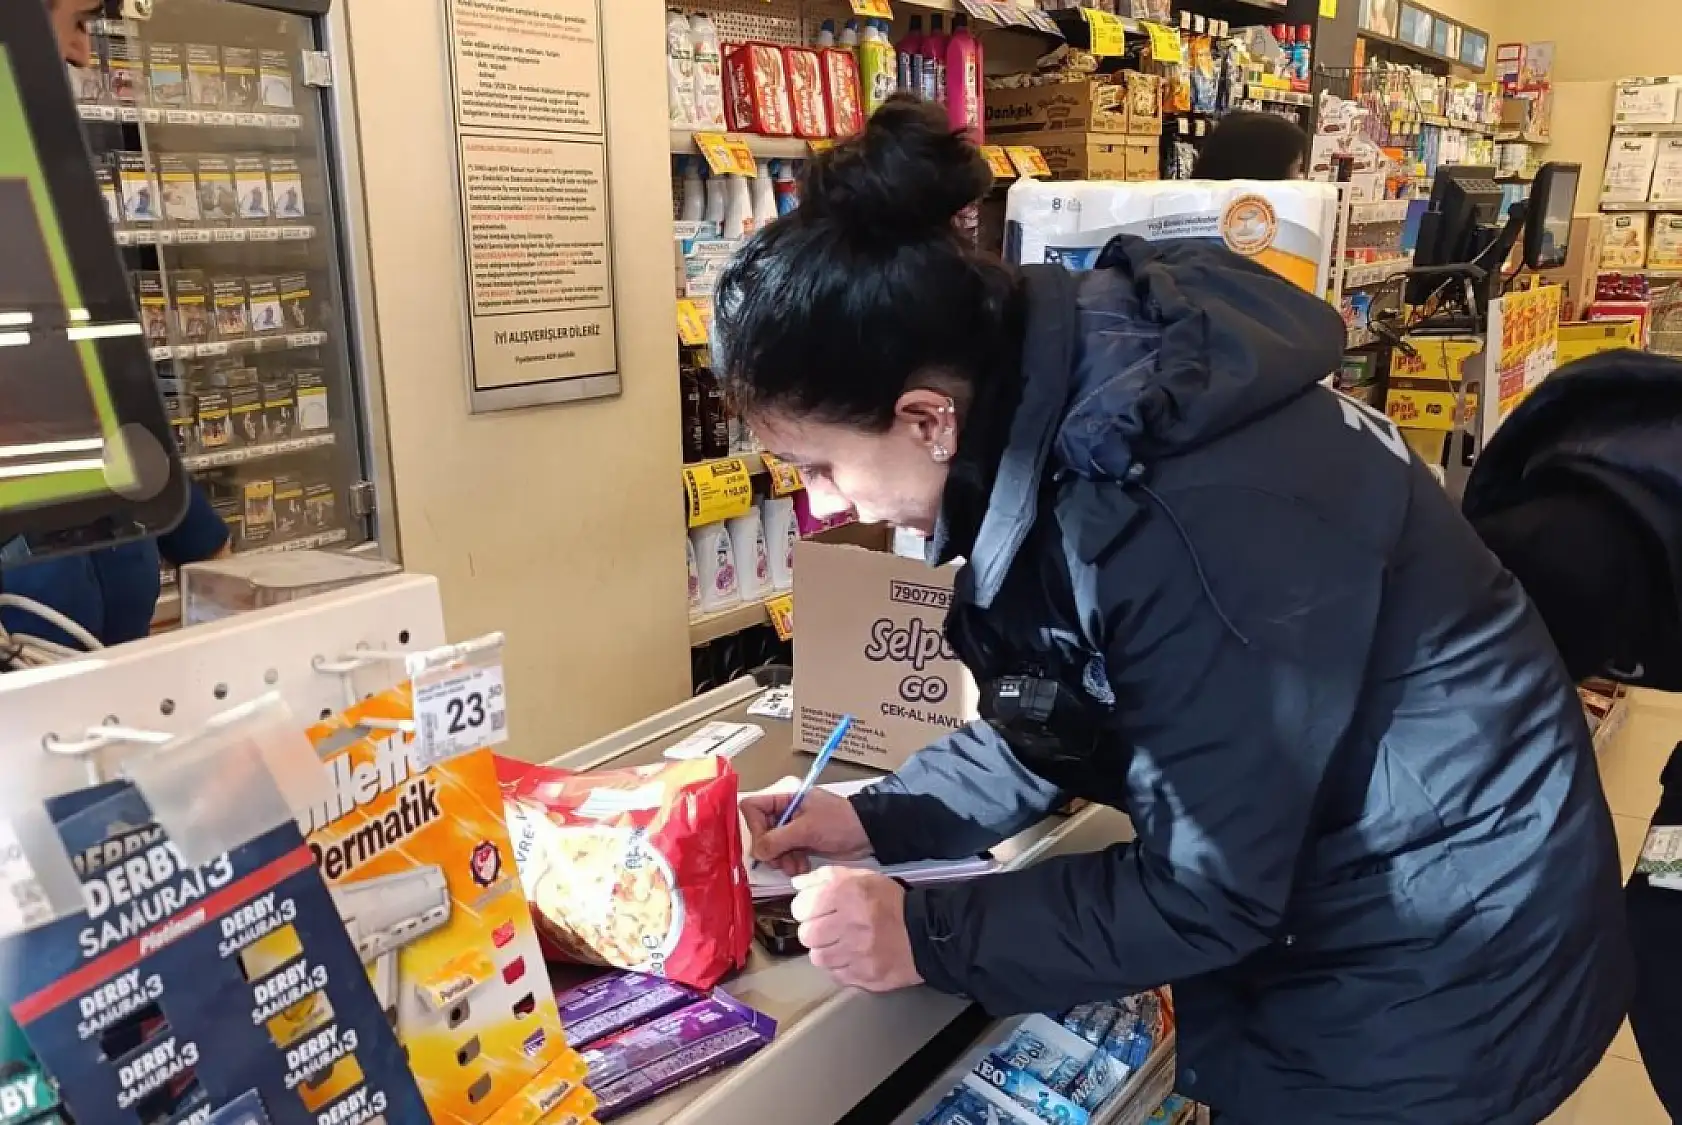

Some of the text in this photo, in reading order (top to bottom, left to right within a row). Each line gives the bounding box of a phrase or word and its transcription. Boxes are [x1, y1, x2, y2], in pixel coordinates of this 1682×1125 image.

[1052, 197, 1061, 210] 8
[508, 325, 569, 345] ALIŞVERİŞLER
[569, 321, 601, 339] DİLERİZ
[899, 675, 948, 703] GO
[446, 692, 486, 735] 23
[220, 892, 278, 938] DERBY
[80, 969, 142, 1019] DERBY
[253, 959, 309, 1004] DERBY
[118, 1038, 177, 1088] DERBY
[285, 1024, 340, 1070] DERBY
